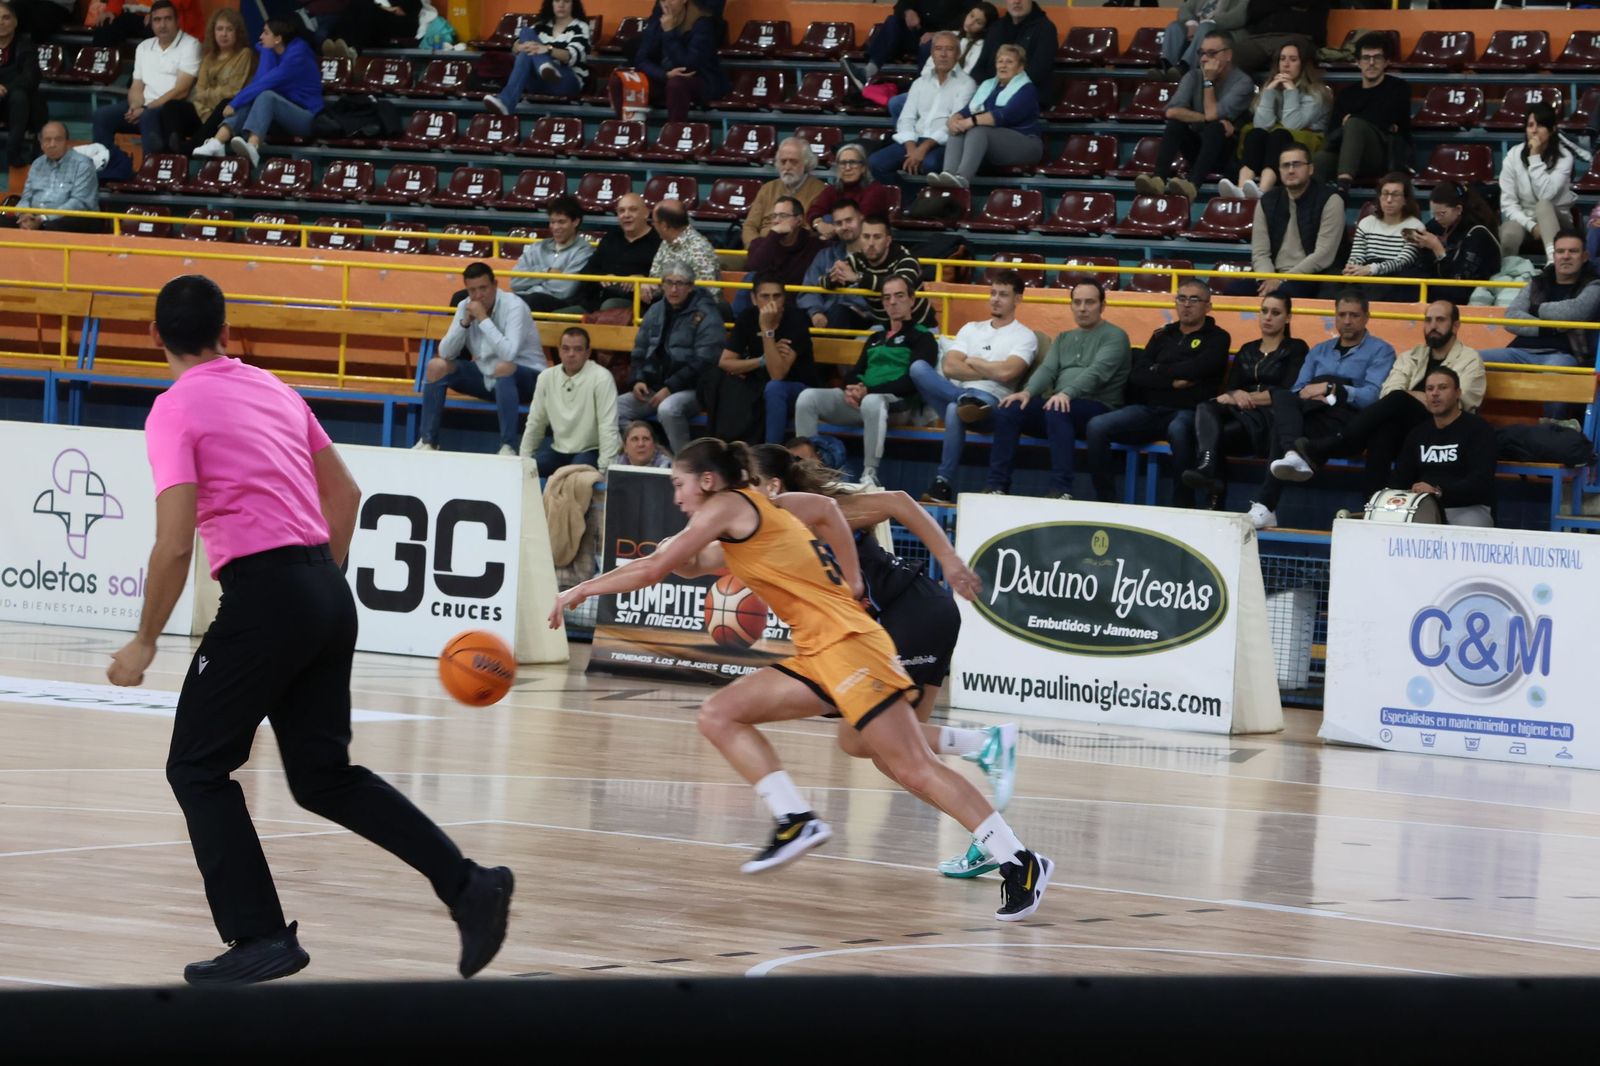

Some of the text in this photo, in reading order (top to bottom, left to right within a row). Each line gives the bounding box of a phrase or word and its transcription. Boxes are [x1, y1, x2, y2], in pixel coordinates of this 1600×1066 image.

[760, 25, 773, 35] 10
[826, 26, 836, 38] 8
[1087, 33, 1095, 44] 1
[1440, 35, 1456, 48] 11
[322, 60, 338, 72] 22
[822, 78, 832, 90] 6
[1158, 89, 1168, 101] 5
[1448, 90, 1465, 104] 13
[1525, 90, 1542, 104] 15
[429, 113, 443, 127] 16
[489, 120, 502, 129] 14
[553, 123, 566, 132] 12
[682, 127, 692, 139] 8
[747, 130, 757, 140] 6
[1088, 140, 1098, 153] 5
[1454, 150, 1470, 161] 15
[160, 159, 173, 169] 22
[221, 160, 238, 173] 20
[284, 163, 296, 173] 18
[408, 170, 420, 180] 14
[471, 173, 484, 183] 12
[536, 175, 550, 185] 10
[602, 178, 612, 191] 8
[668, 181, 678, 193] 6
[736, 185, 743, 195] 4
[1012, 194, 1022, 207] 5
[1083, 197, 1094, 210] 7
[1157, 199, 1167, 212] 9
[1227, 202, 1241, 213] 11
[1420, 444, 1459, 463] VANS
[345, 493, 506, 613] 3C
[1389, 536, 1584, 570] LAVANDERÍA Y TINTORERÍA INDUSTRIAL
[1, 559, 97, 594] coletas
[990, 548, 1213, 618] Paulino Iglesias
[616, 582, 707, 617] COMPITE
[431, 601, 503, 621] CRUCES
[644, 612, 705, 630] MIEDOS
[1027, 615, 1159, 640] Embutidos y Jamones
[1411, 607, 1553, 677] C&M
[610, 652, 653, 664] TENEMOS
[655, 656, 674, 666] LOS
[676, 660, 718, 671] MEJORES
[962, 671, 1221, 717] www.paulinoiglesias.com
[1381, 709, 1571, 739] Especialistas en mantenimiento e higiene textil
